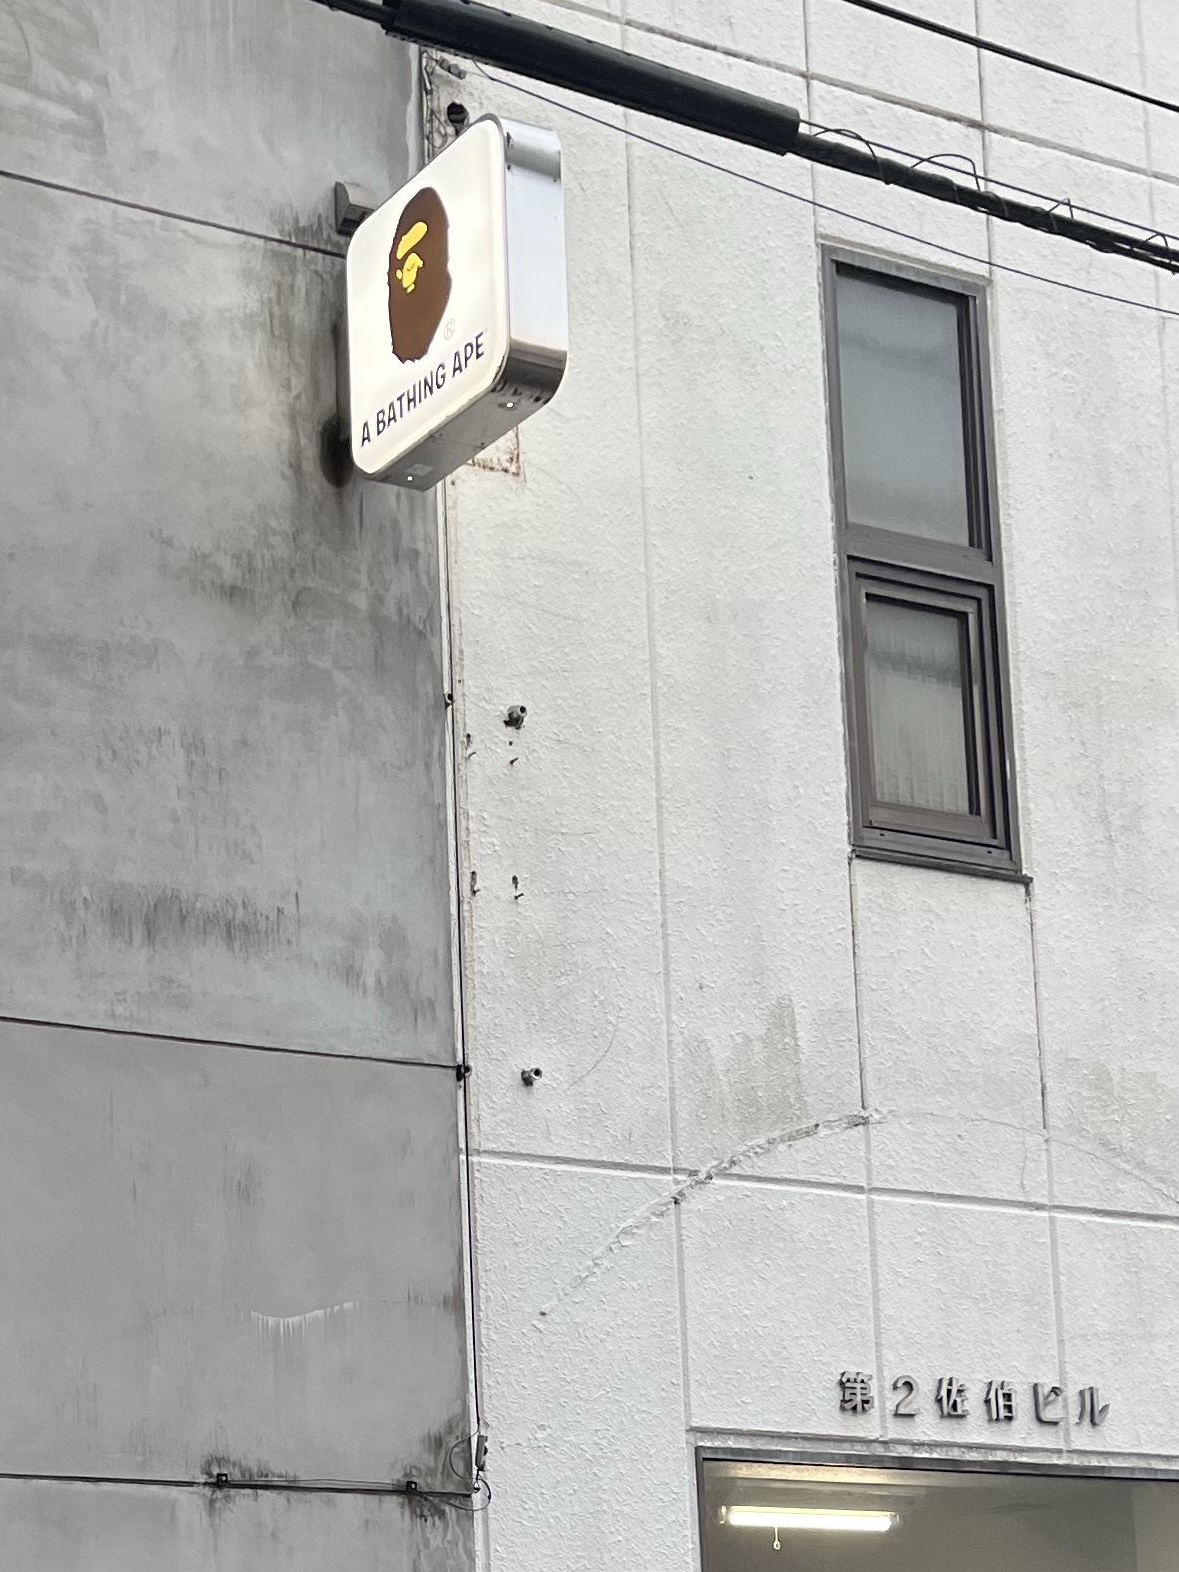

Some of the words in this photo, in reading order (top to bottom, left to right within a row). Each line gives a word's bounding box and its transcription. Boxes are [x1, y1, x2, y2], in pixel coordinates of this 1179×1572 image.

[361, 420, 371, 447] A
[376, 363, 446, 437] BATHING
[452, 331, 485, 379] APE
[837, 1370, 1111, 1427] 第2佐伯ビル
